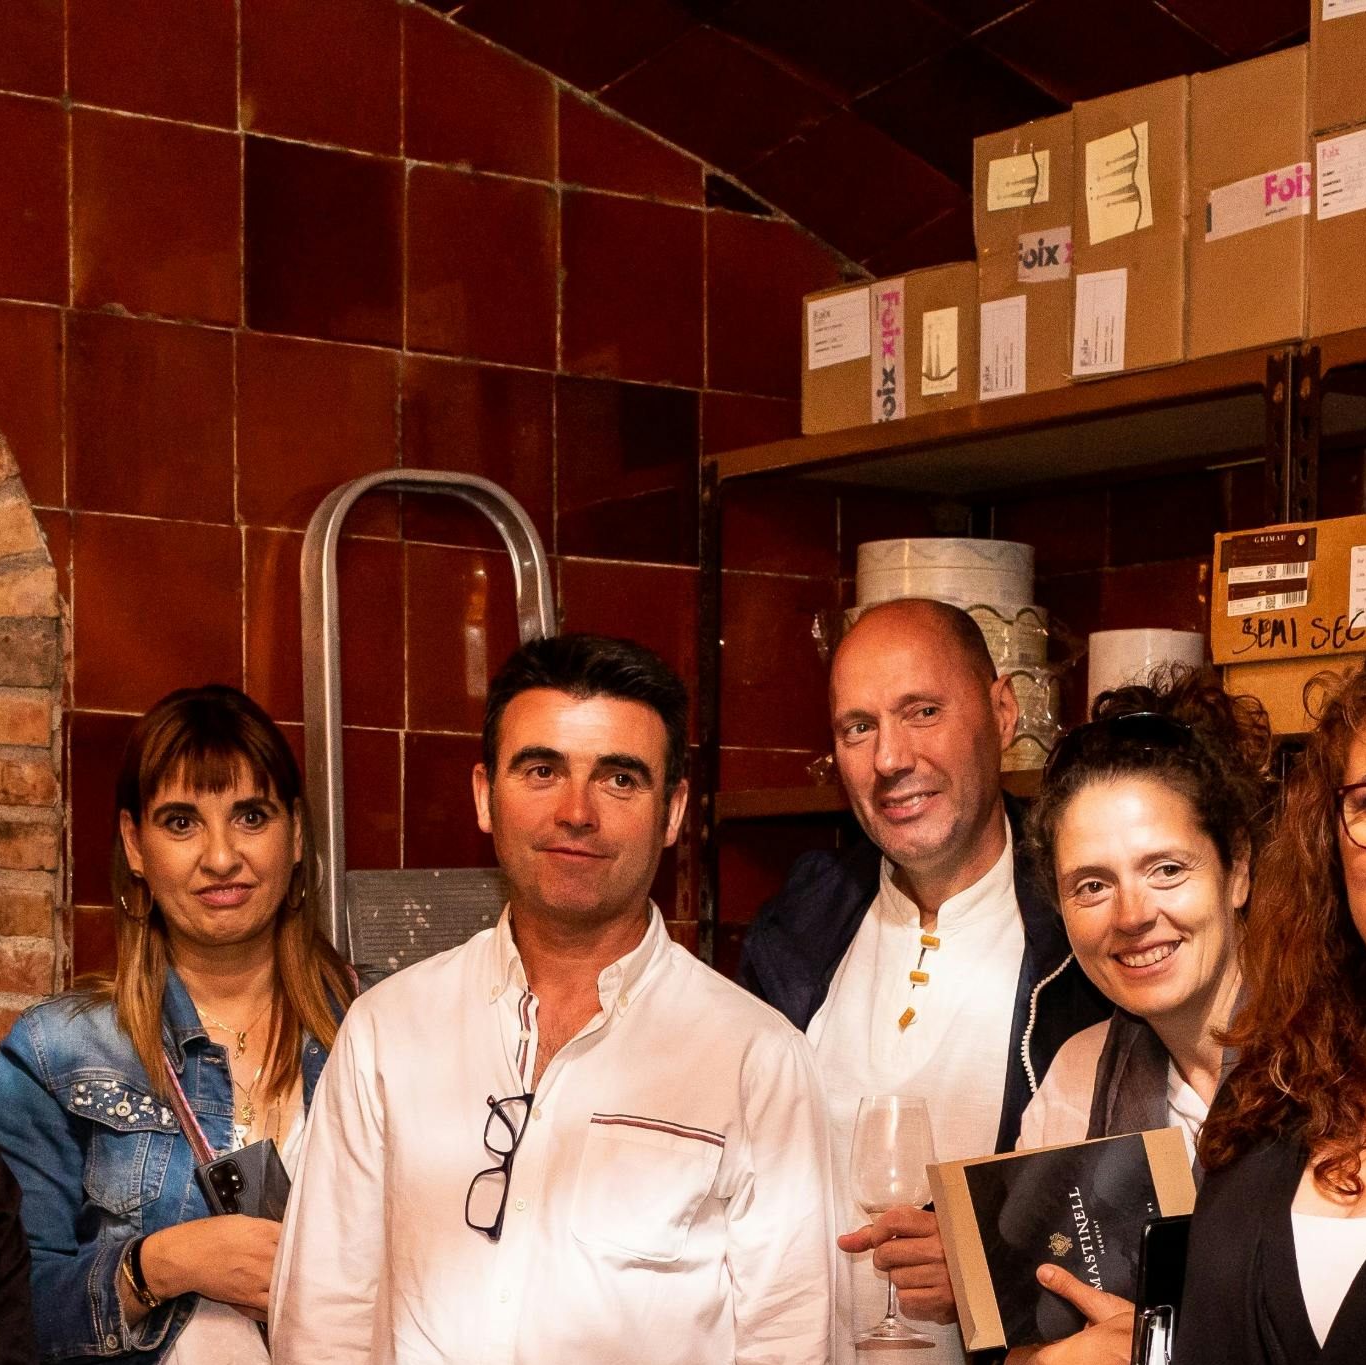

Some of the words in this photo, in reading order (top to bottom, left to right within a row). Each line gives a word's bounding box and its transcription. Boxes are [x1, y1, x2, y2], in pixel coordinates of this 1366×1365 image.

[879, 291, 902, 358] Foix
[1254, 534, 1286, 544] GRIMAU
[1310, 610, 1366, 650] SEC
[1068, 1186, 1104, 1291] MASTINELL
